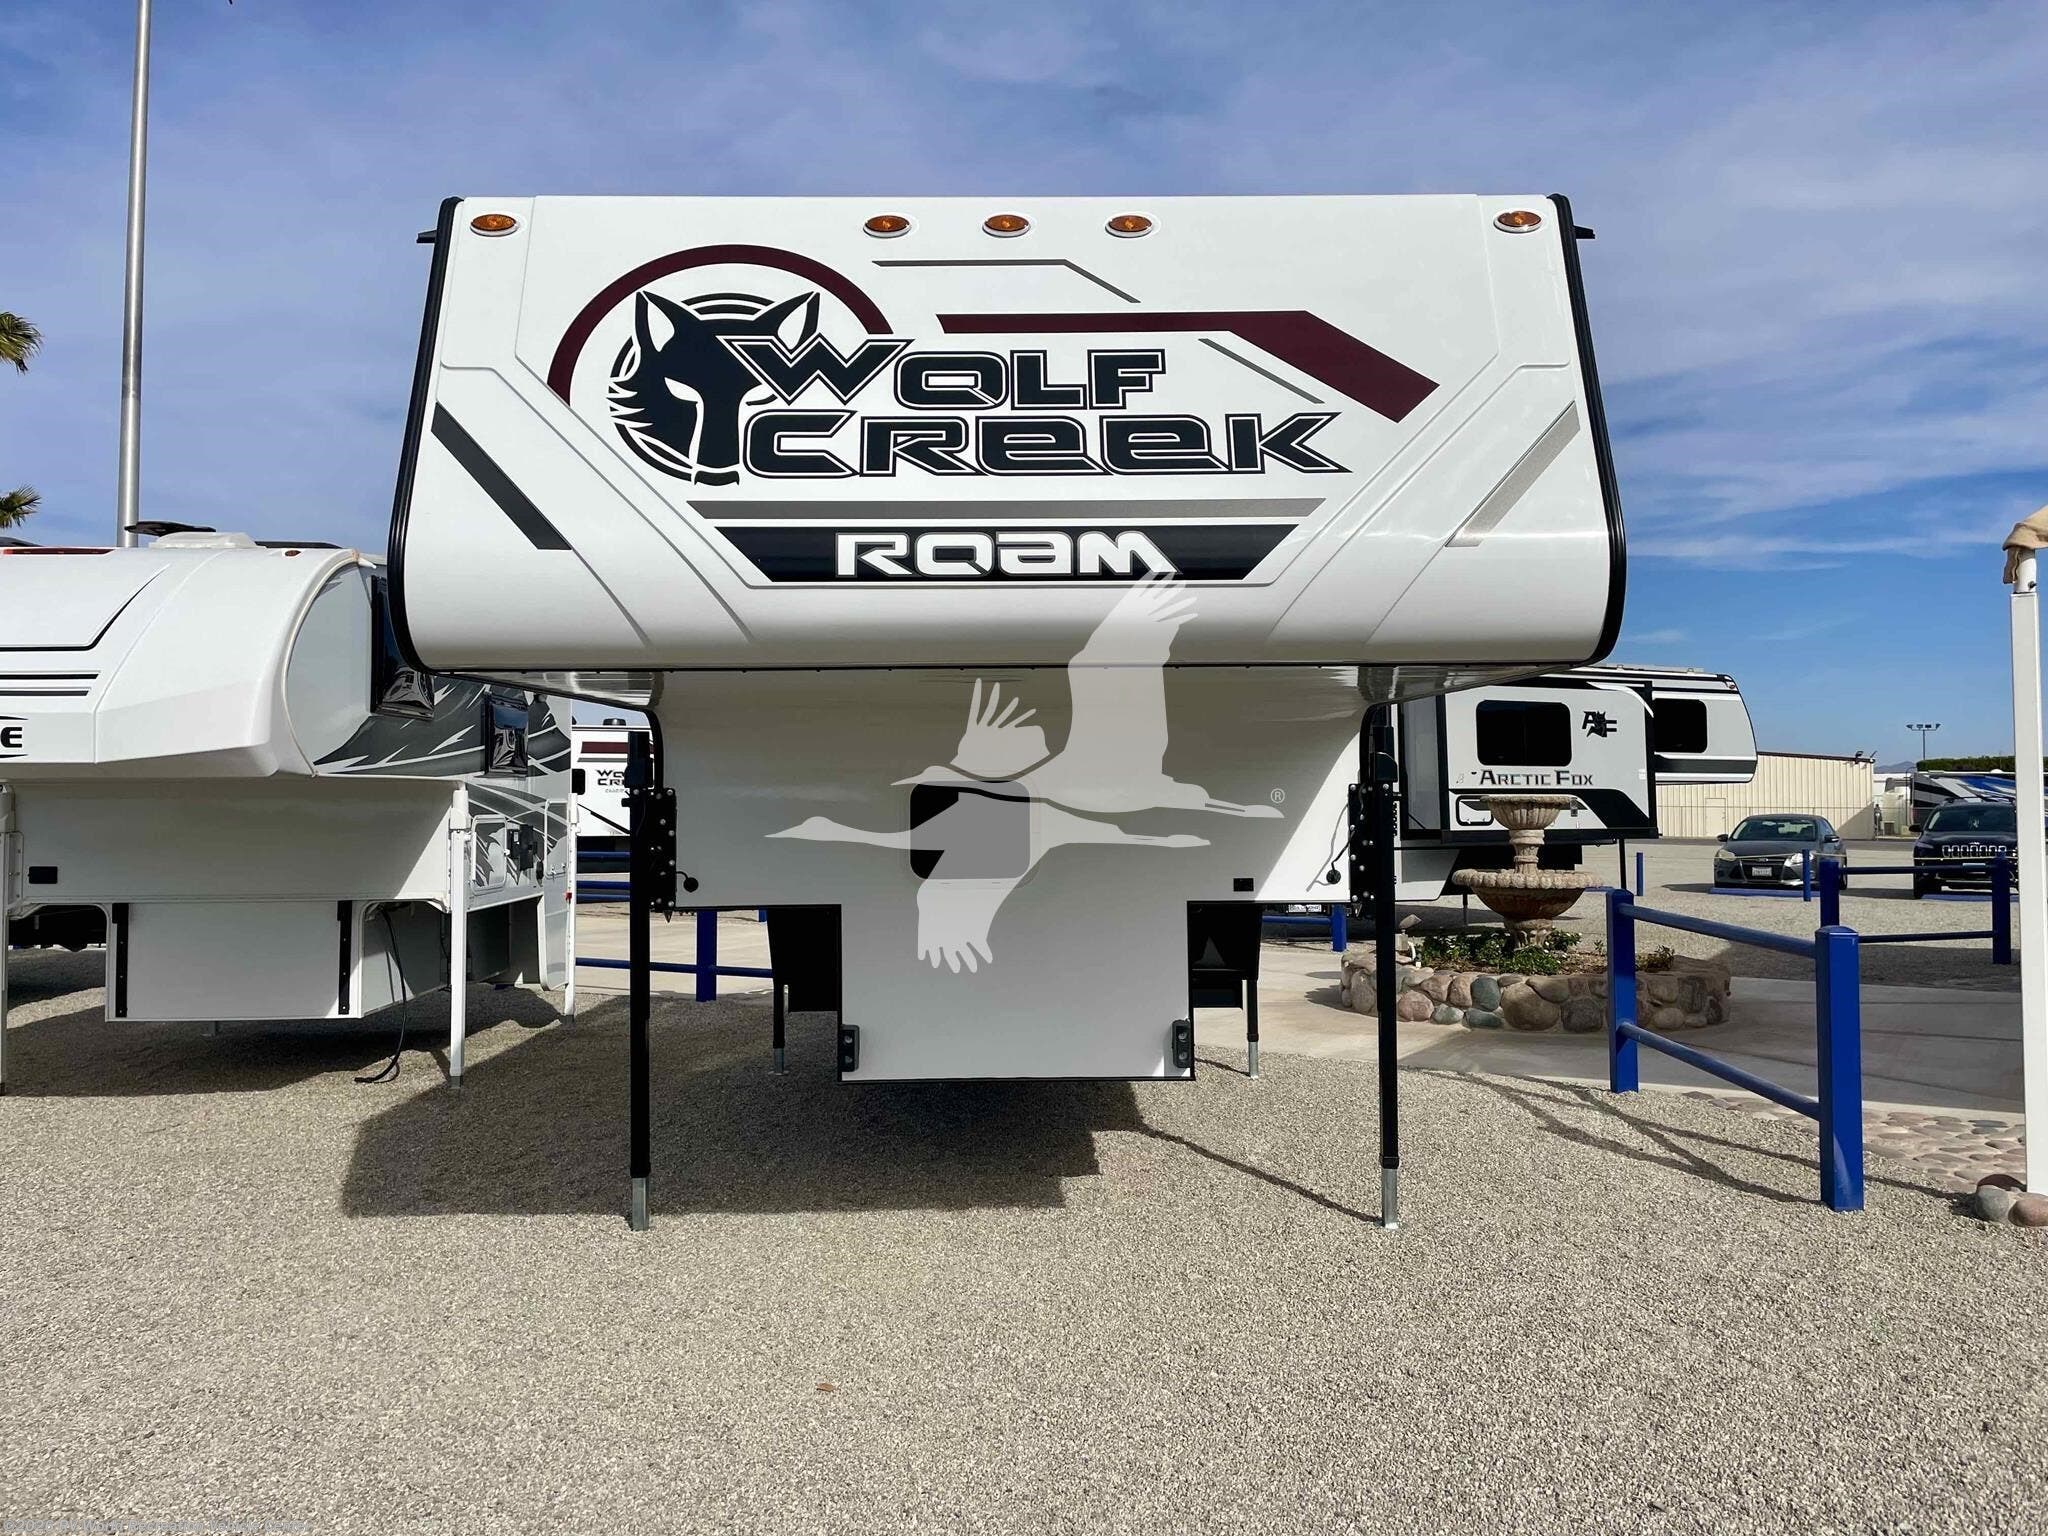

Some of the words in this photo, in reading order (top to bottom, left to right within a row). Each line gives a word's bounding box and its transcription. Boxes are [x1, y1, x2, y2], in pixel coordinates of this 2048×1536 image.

[717, 334, 1167, 412] WOLF
[740, 409, 1353, 479] CREEK
[834, 530, 1181, 579] ROAM
[596, 769, 625, 778] WO
